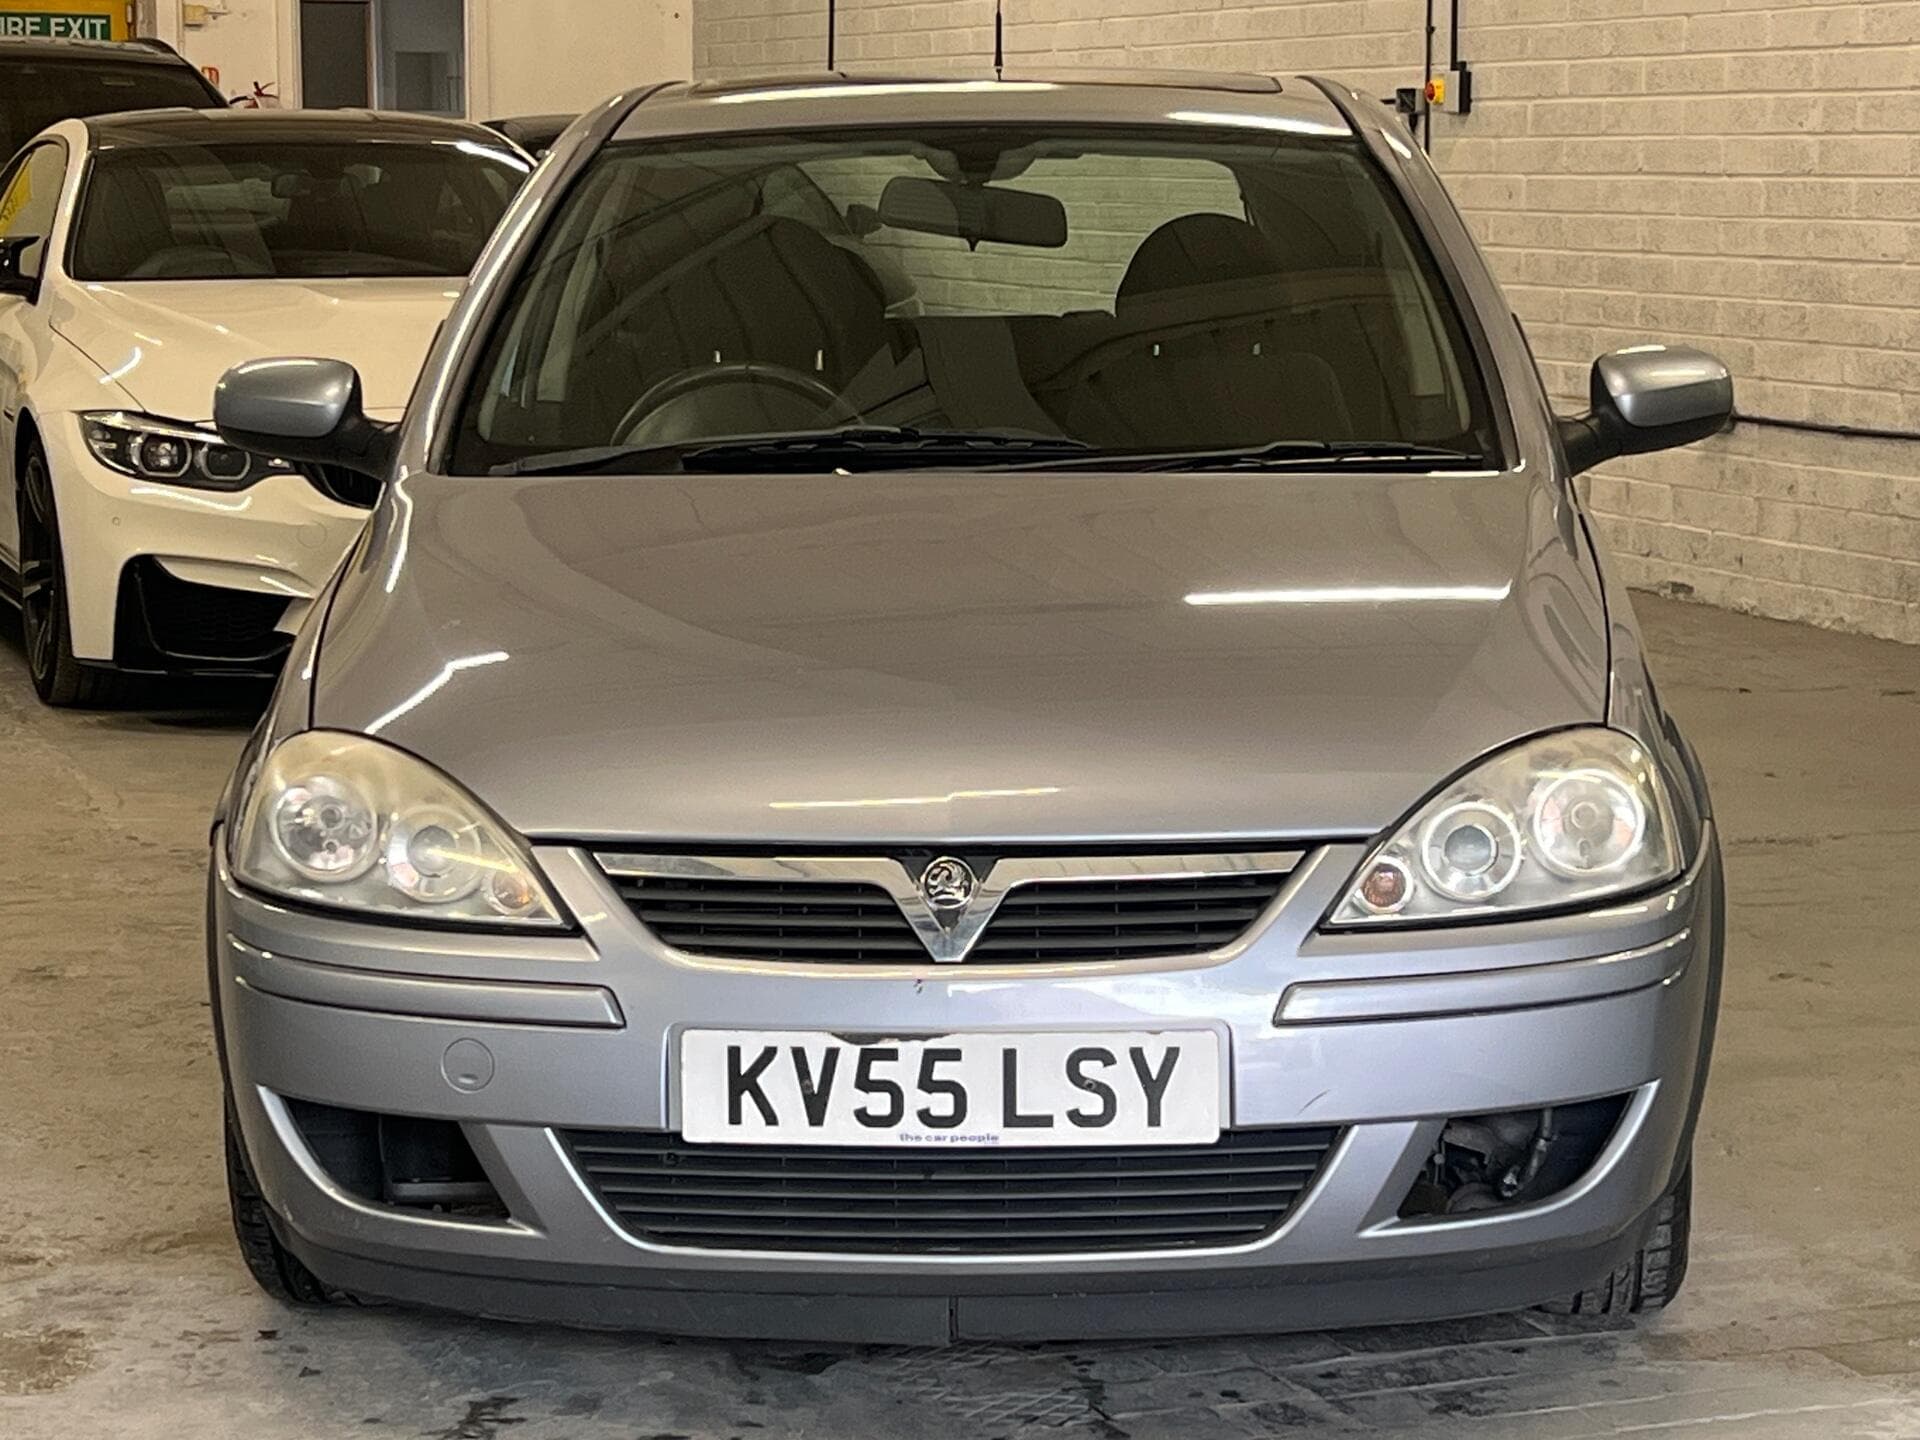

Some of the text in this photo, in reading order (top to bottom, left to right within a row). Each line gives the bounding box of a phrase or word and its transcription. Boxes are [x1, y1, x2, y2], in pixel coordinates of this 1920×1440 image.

[50, 17, 107, 41] EXIT
[727, 1045, 1180, 1128] KV55 LSY
[900, 1133, 923, 1142] the
[925, 1134, 947, 1142] car
[950, 1133, 999, 1144] people
